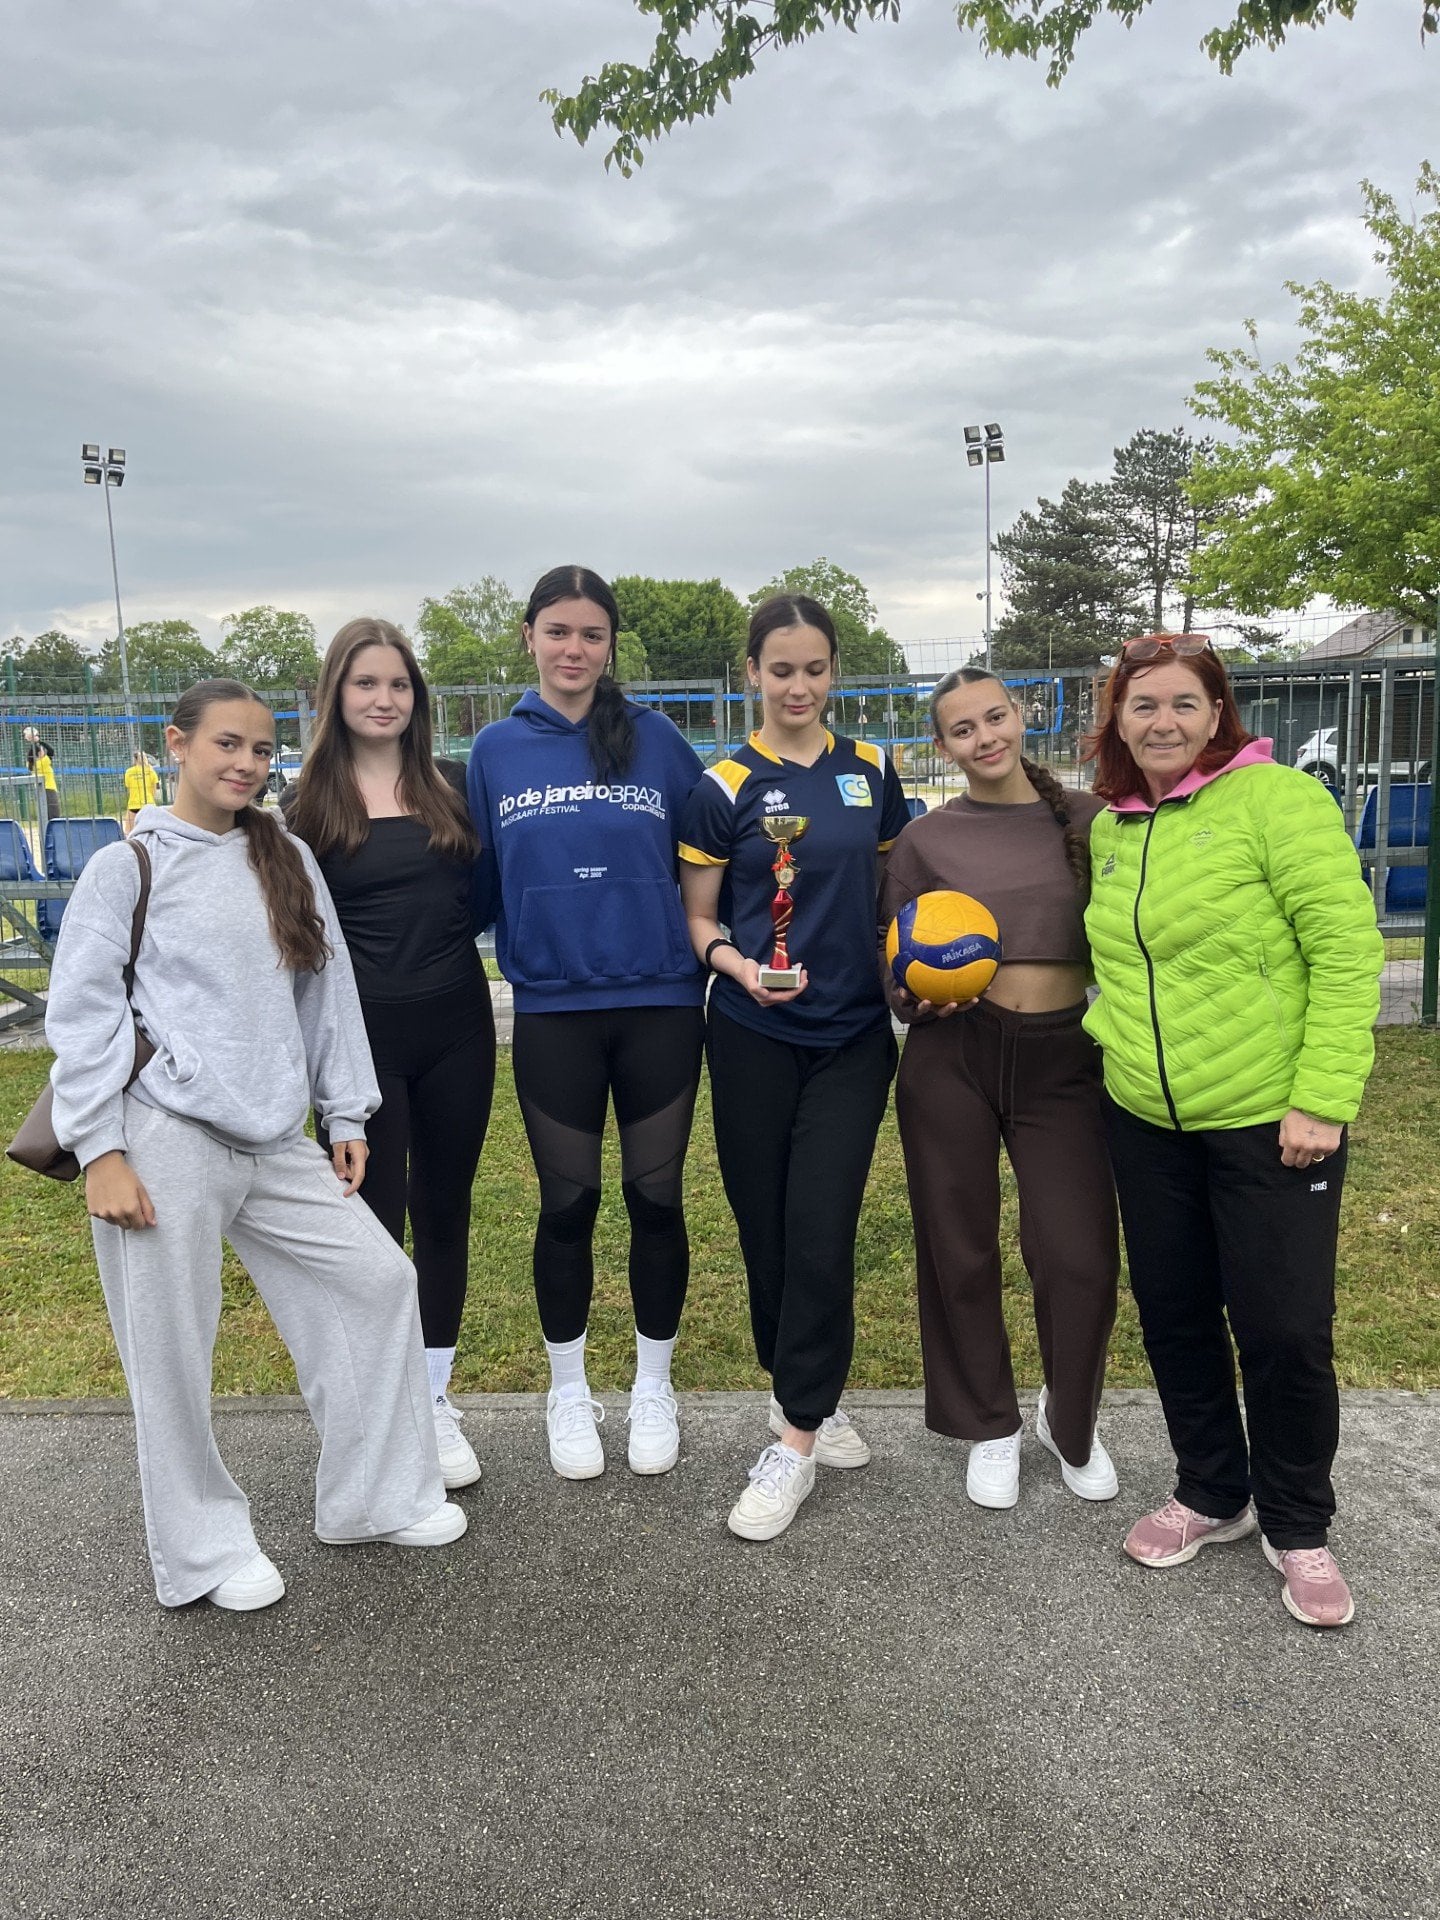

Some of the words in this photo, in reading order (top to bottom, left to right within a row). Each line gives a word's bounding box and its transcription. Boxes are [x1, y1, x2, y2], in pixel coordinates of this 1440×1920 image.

[499, 794, 515, 817] rio
[517, 788, 542, 808] de
[539, 805, 581, 815] FESTIVAL
